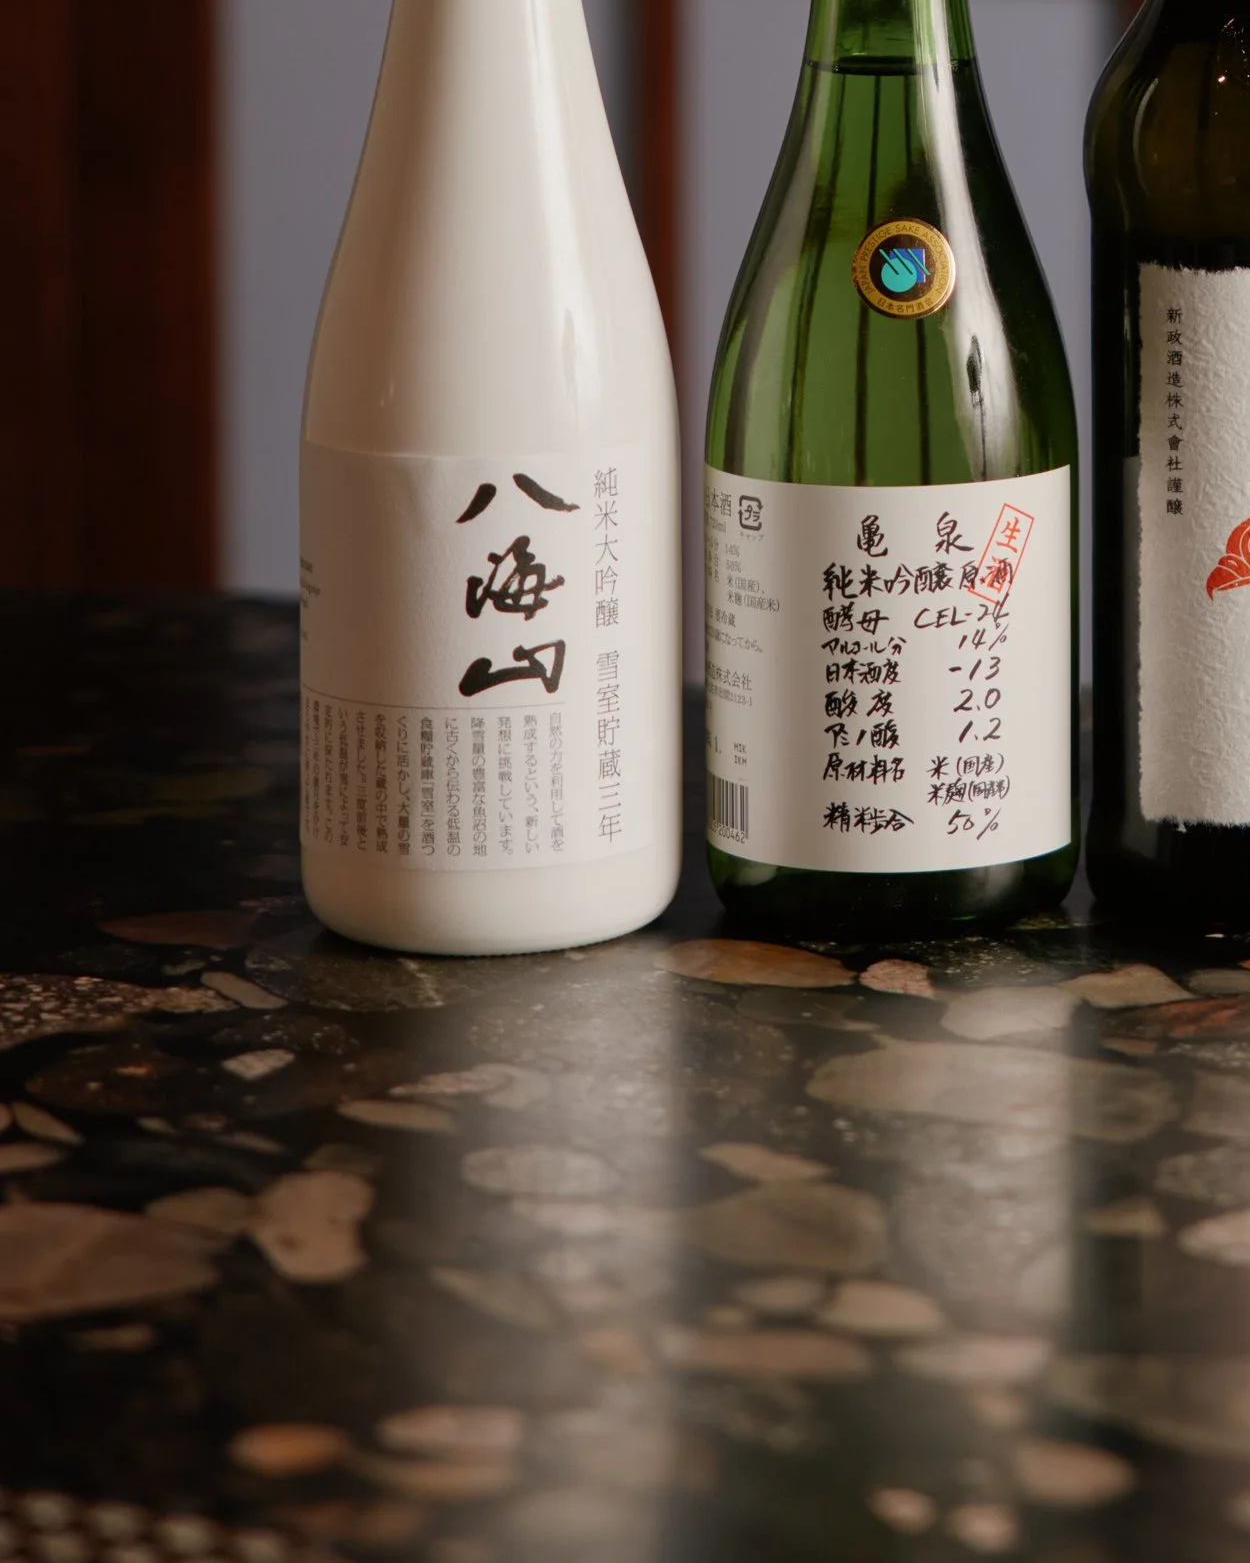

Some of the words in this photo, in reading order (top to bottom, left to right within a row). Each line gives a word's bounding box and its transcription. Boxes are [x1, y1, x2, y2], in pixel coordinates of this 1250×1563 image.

[861, 226, 893, 261] PRESTIGE
[896, 224, 920, 234] SAKE
[922, 232, 949, 294] ASSOCIATION
[860, 264, 876, 295] JAPAN
[593, 467, 620, 628] 純米大吟醸
[456, 473, 581, 697] 八海山
[958, 622, 1009, 651] 14%
[826, 658, 901, 685] 日本酒度
[949, 656, 1001, 680] -13
[953, 688, 1001, 713] 2.0
[596, 650, 623, 842] 雪室貯蔵三年
[958, 717, 1001, 743] 1.2
[823, 752, 905, 785] 原材料名
[947, 808, 1001, 840] 50%
